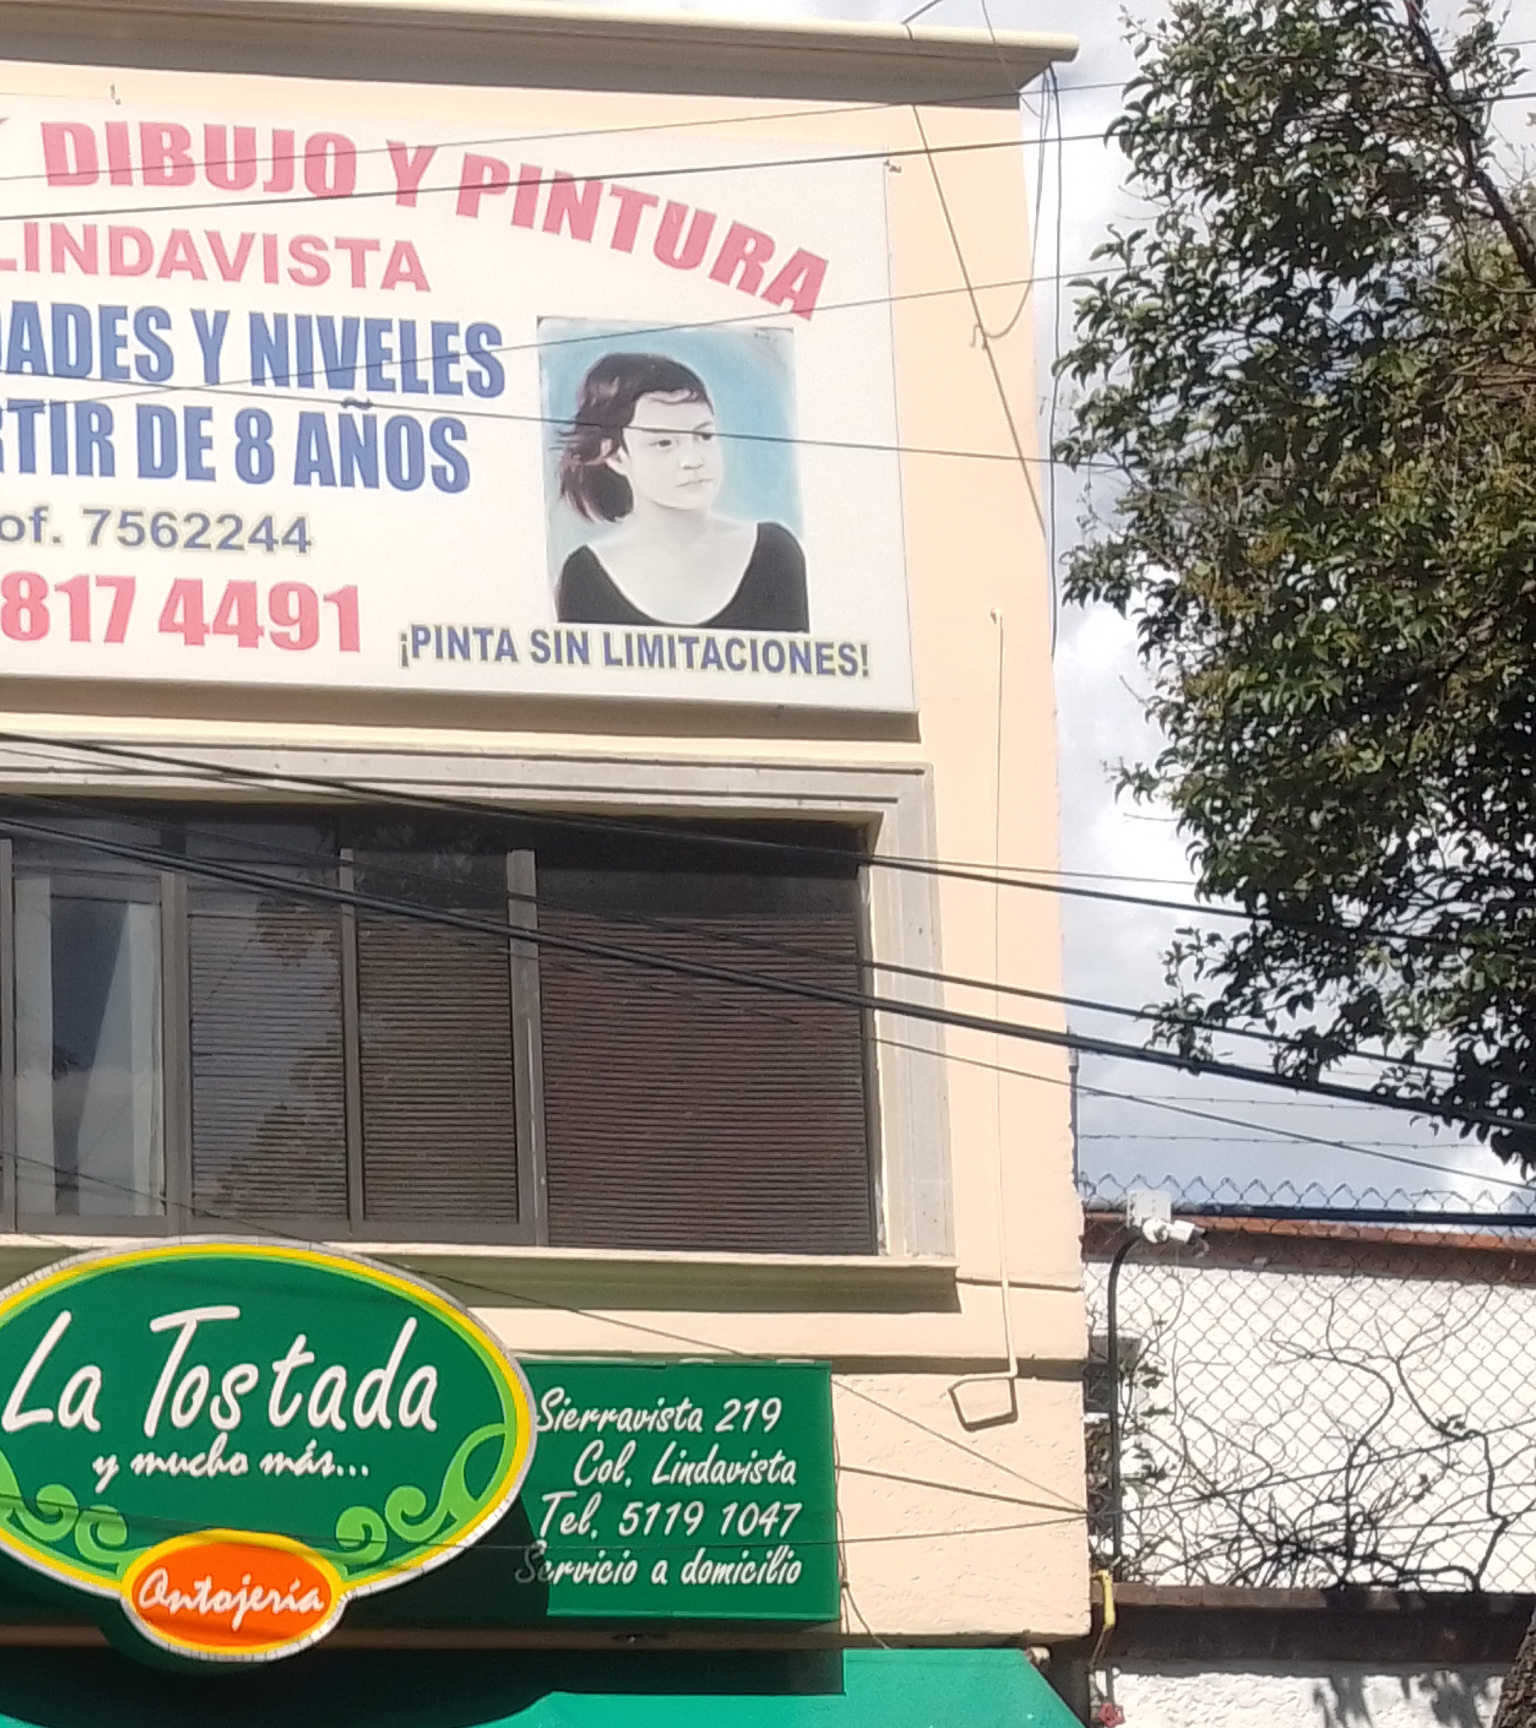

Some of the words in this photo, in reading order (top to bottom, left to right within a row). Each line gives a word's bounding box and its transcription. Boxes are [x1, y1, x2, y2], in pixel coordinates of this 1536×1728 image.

[40, 120, 359, 199] DIBUJO
[386, 139, 439, 207] Y
[455, 151, 829, 321] PINTURA
[189, 307, 230, 386] Y
[248, 311, 505, 399] NIVELES
[136, 402, 219, 483] DE
[234, 404, 275, 487] 8
[292, 397, 471, 494] AÑOS
[81, 505, 313, 556] 7562244
[157, 575, 361, 655] 4491
[398, 623, 519, 670] ¡PINTA
[529, 629, 590, 666] SIN
[603, 632, 871, 679] LIMITACIONES!
[0, 1310, 104, 1434] La
[143, 1305, 440, 1438] Tostada
[534, 1386, 704, 1433] Sierravista
[714, 1397, 783, 1433] 219
[92, 1450, 120, 1494] y
[130, 1432, 251, 1477] mucho
[259, 1439, 370, 1478] más...
[572, 1439, 637, 1488] Col.
[651, 1440, 798, 1487] Lindavista
[539, 1491, 603, 1539] Tel.
[618, 1500, 706, 1537] 5119
[720, 1501, 803, 1538] 1047
[514, 1539, 639, 1585] Servicio
[650, 1559, 670, 1586] a
[680, 1545, 803, 1585] domicilio
